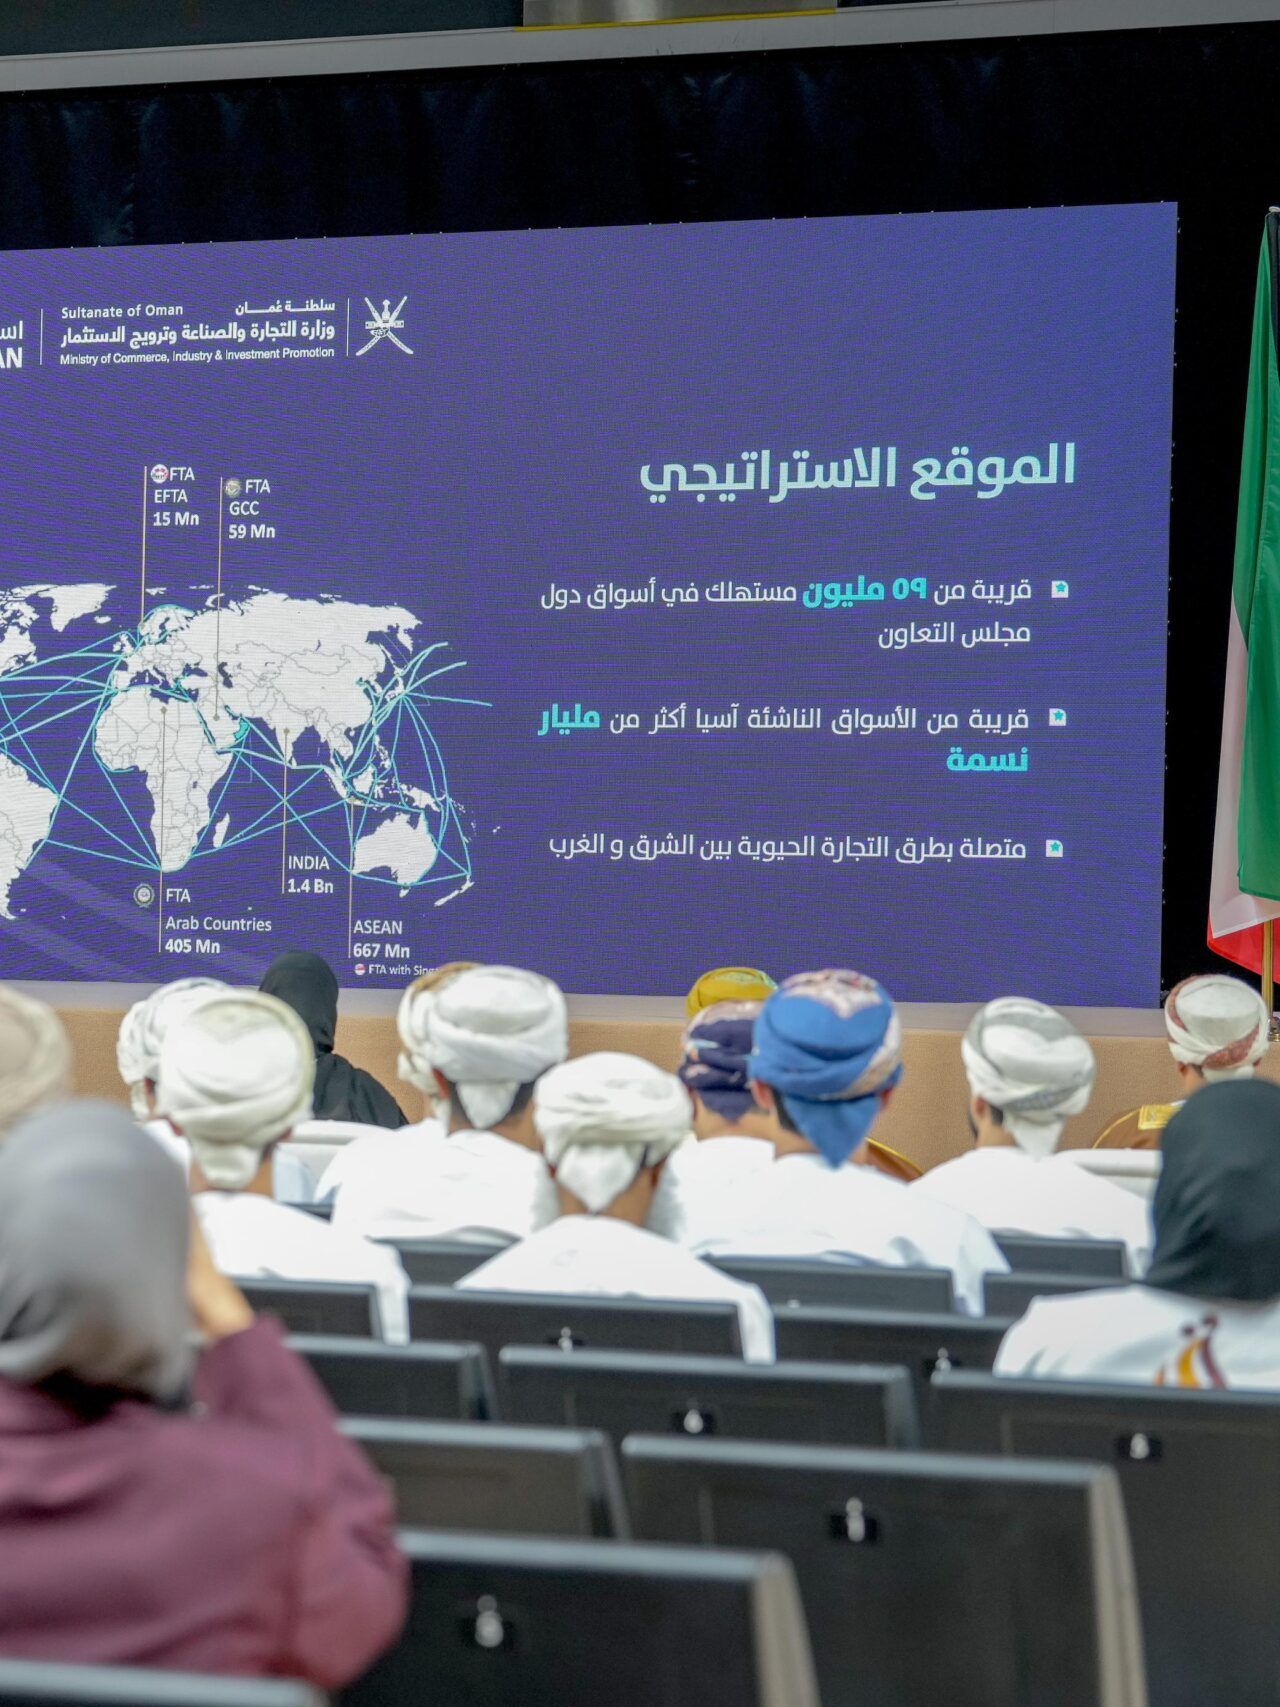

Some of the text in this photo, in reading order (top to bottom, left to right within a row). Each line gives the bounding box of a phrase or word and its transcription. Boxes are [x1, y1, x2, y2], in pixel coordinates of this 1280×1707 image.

[61, 304, 184, 319] Sultanate of Oman
[60, 318, 336, 349] وزارة التجارة والصناعة وترويج الاستثمار
[60, 346, 335, 367] Ministry of Commerce, Industry & Investment Promotion
[169, 466, 196, 481] FTA
[640, 442, 1075, 504] الموقع الاستراتيجي
[245, 478, 271, 494] FTA
[154, 488, 188, 504] EFTA
[229, 500, 260, 516] GCC
[153, 511, 200, 527] 15 Mn
[228, 523, 276, 539] 59 Mn
[540, 574, 1032, 610] قريبة من ٥٩ مليون مستهلك في أسواق دول
[878, 621, 1031, 650] مجلس التعاون
[537, 702, 1029, 736] قريبة من الأسواق الناشئة آسيا أكثر من مليار
[946, 746, 1029, 772] نسمة
[549, 832, 1027, 865] متصلة بطرق التجارة الحيوية بين الشرق و الغرب
[288, 855, 330, 871] INDIA
[287, 878, 334, 894] 1.4 Bn
[166, 888, 191, 903] FTA
[165, 915, 272, 932] Arab Countries
[353, 919, 403, 935] ASEAN
[164, 938, 221, 954] 405 Mn
[353, 942, 410, 959] 667 Mn
[368, 963, 387, 975] FTA
[389, 963, 411, 975] with
